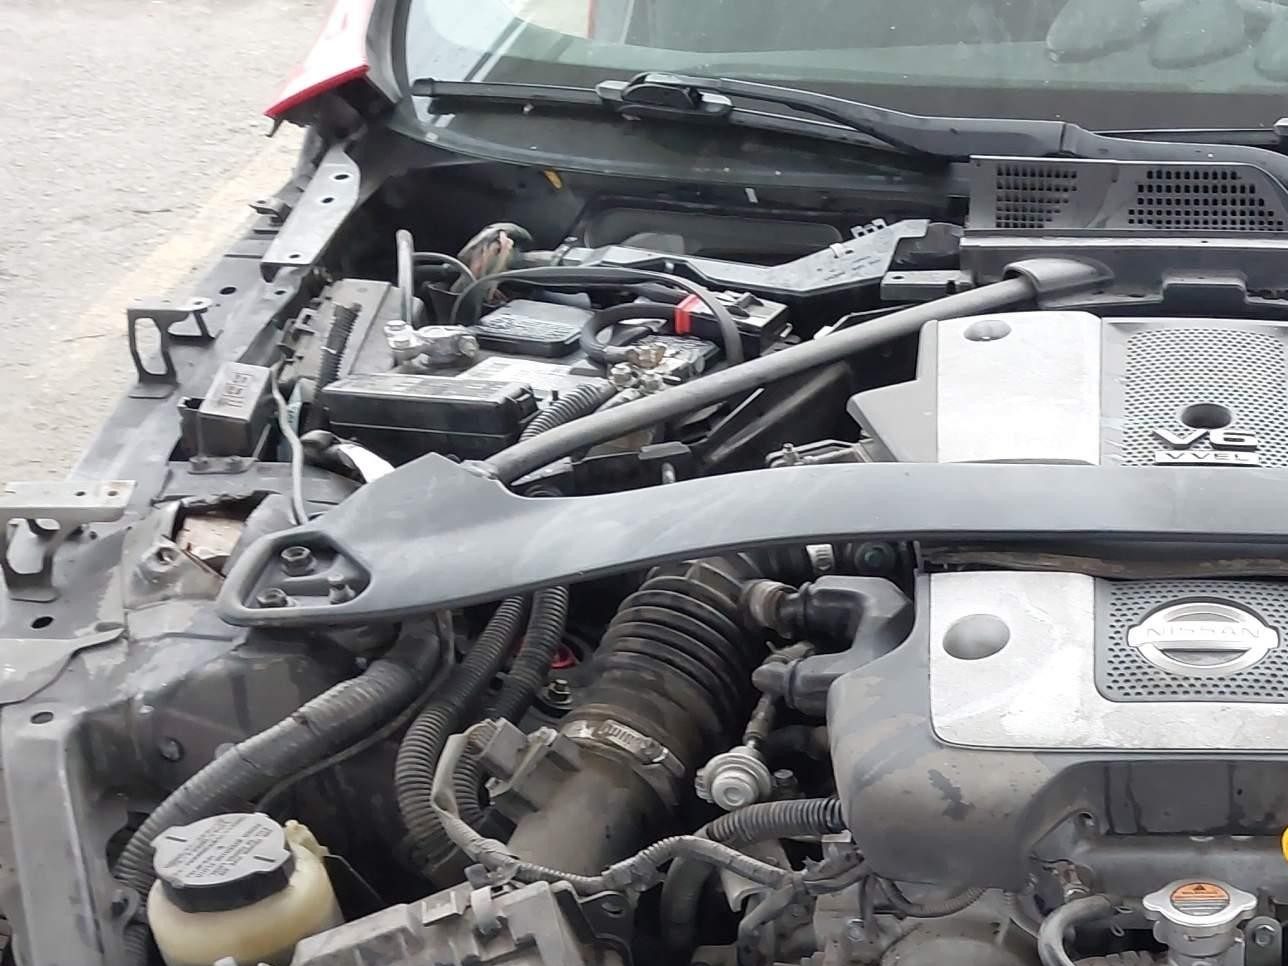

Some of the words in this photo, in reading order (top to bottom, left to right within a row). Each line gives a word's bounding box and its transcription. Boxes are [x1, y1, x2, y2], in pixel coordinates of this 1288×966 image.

[1152, 428, 1259, 451] V6
[1165, 452, 1250, 462] VVEL
[1146, 627, 1260, 639] NISSAN
